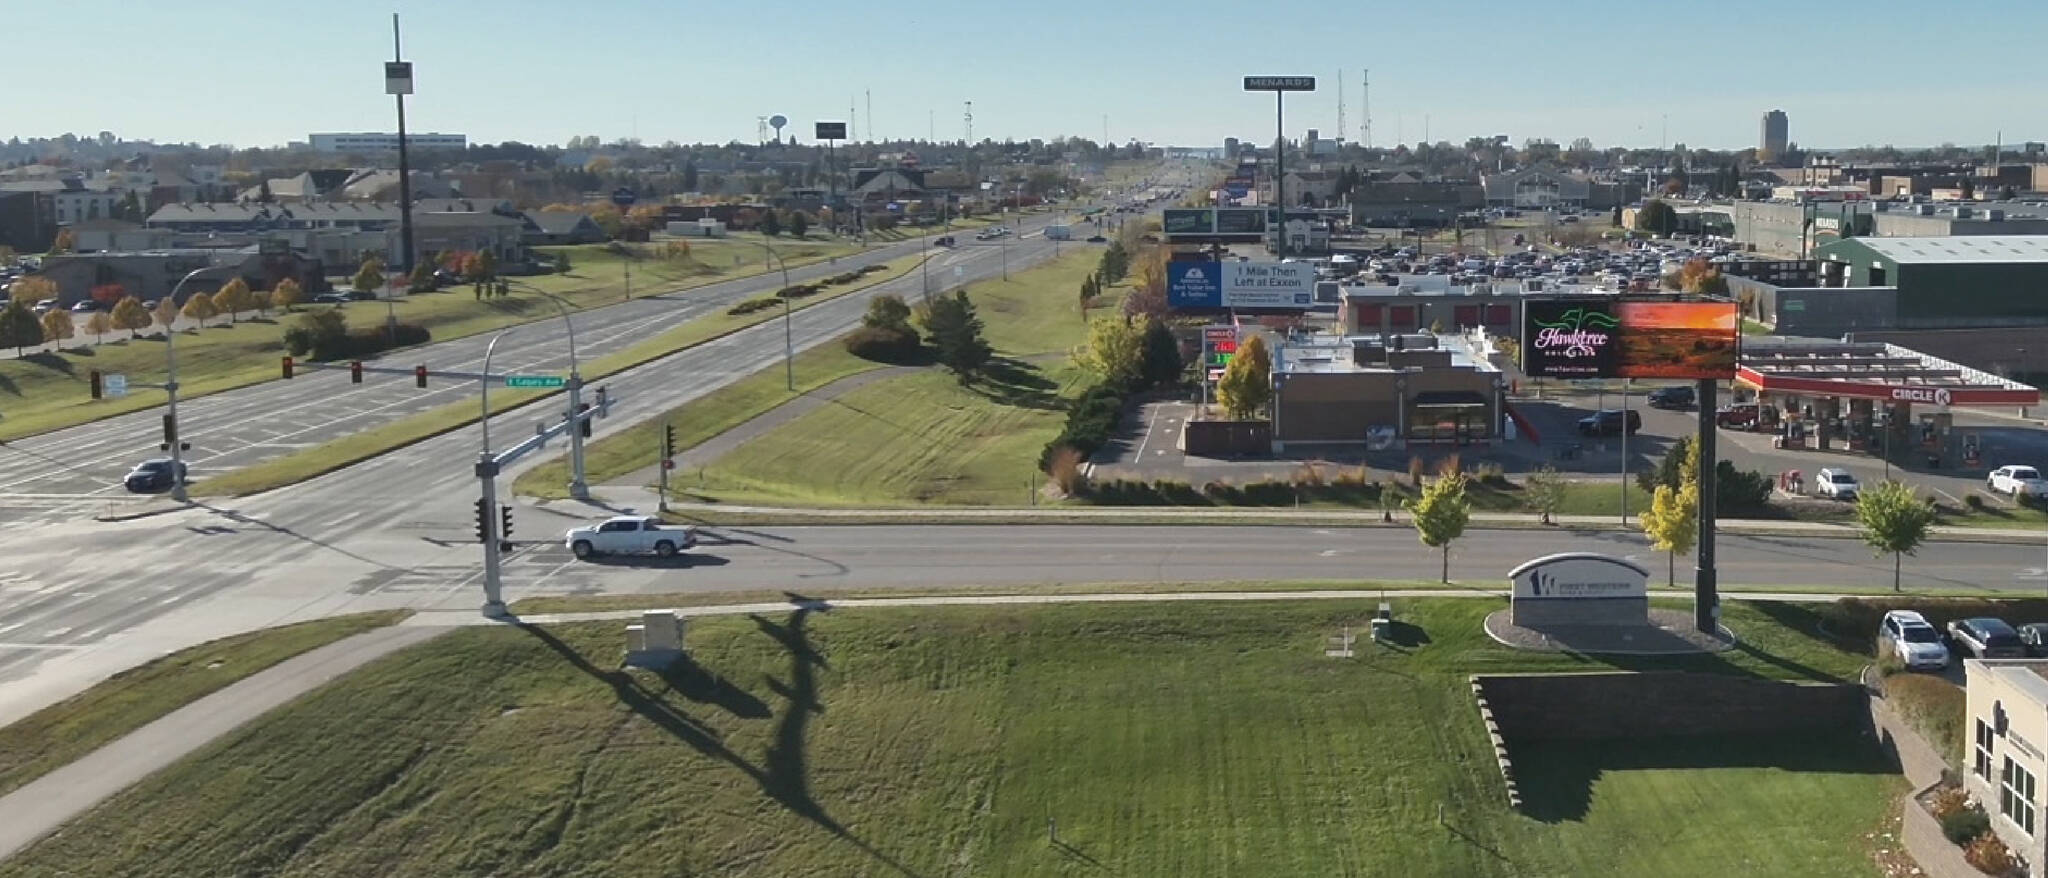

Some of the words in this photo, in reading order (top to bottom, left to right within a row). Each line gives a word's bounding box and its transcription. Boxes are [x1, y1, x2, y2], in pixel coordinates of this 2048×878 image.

[1249, 78, 1312, 87] MENARDS
[1246, 266, 1268, 276] Mile
[1271, 266, 1297, 276] Then
[1235, 277, 1254, 287] Left
[1257, 278, 1266, 287] at
[1269, 277, 1302, 288] Exxon
[1534, 327, 1608, 349] Hawktree
[1891, 388, 1934, 401] CIRCLE
